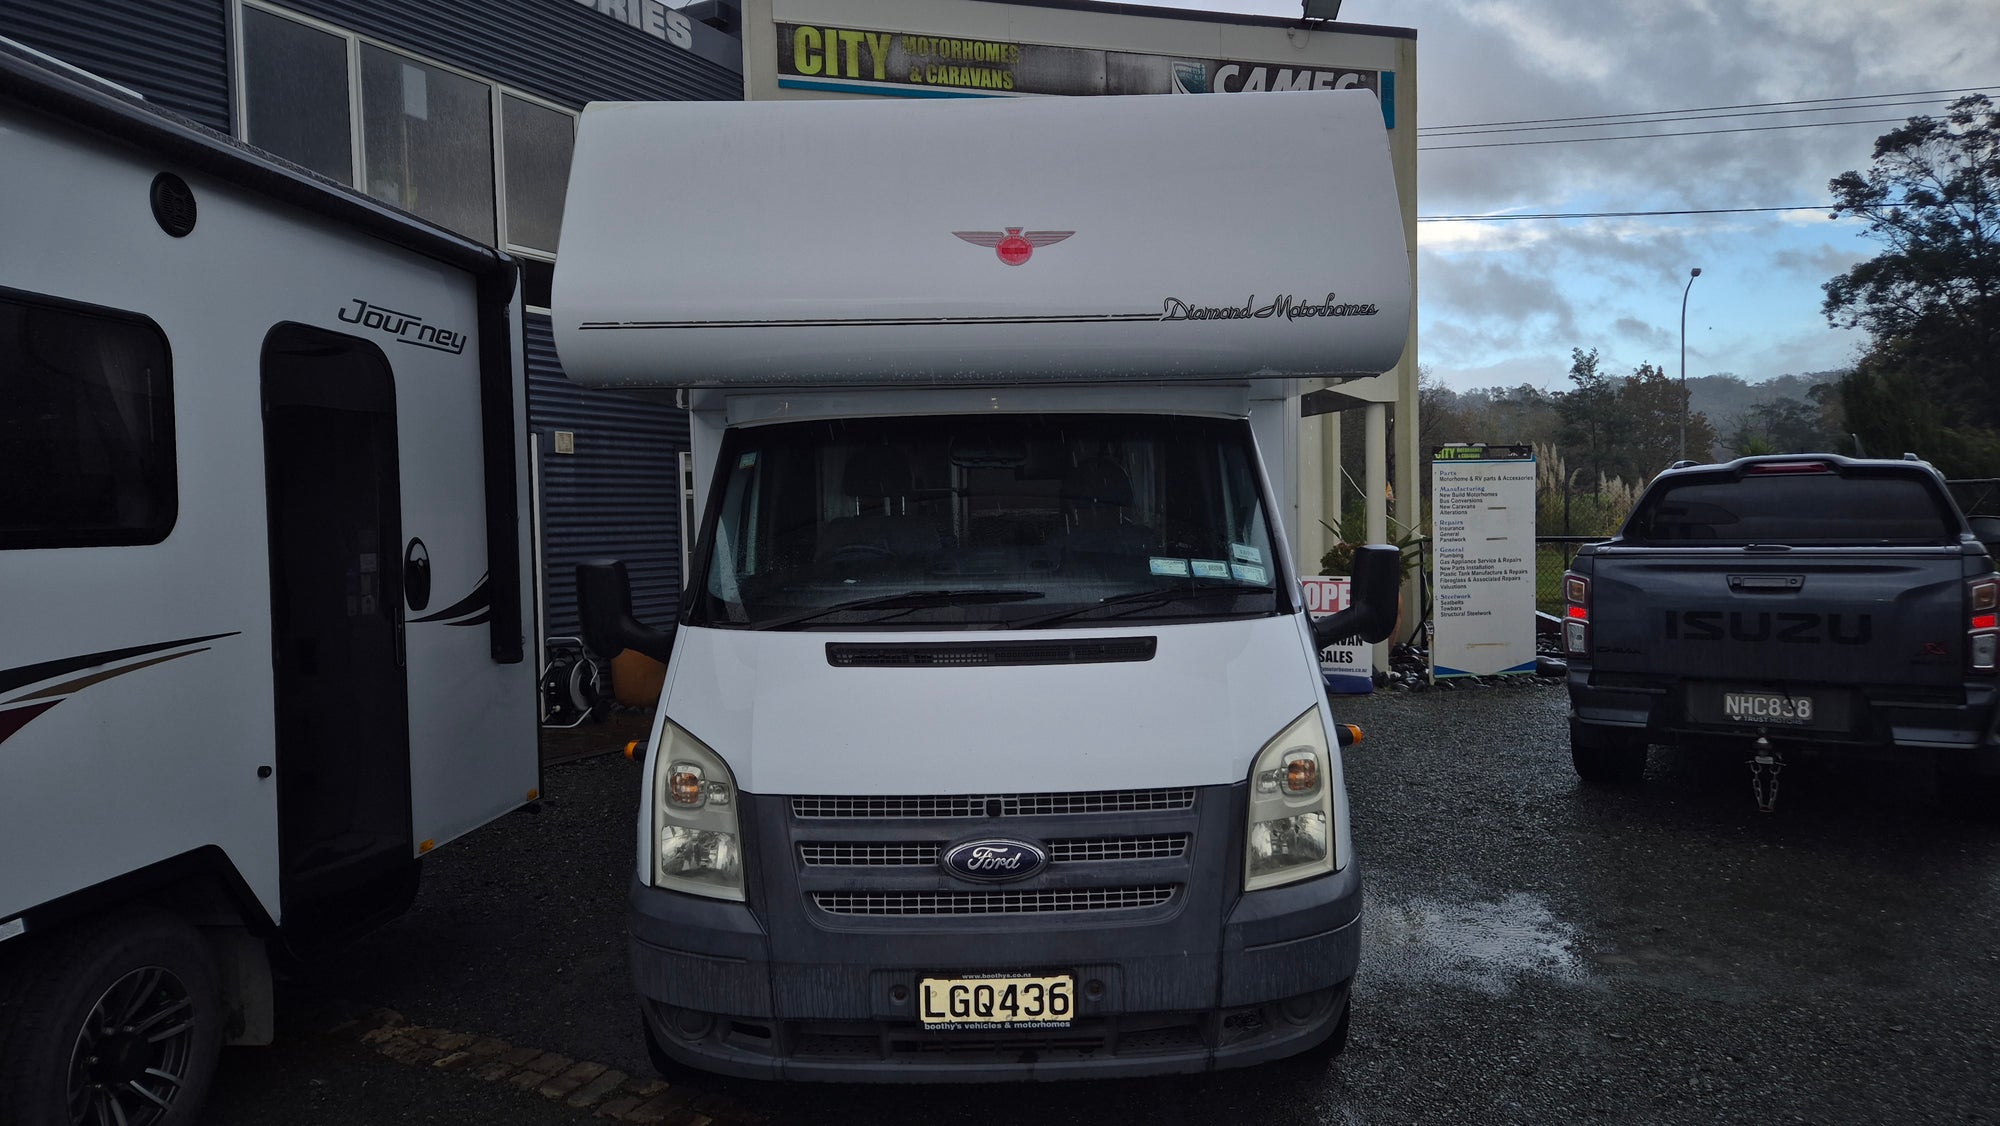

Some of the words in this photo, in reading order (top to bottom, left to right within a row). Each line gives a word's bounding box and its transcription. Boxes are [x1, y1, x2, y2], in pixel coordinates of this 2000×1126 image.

[573, 0, 692, 50] RIES
[793, 26, 892, 80] CITY
[901, 35, 1019, 64] MOTORHOMES
[909, 65, 923, 82] &
[926, 64, 1014, 90] CARAVANS
[1161, 294, 1255, 321] Diamond
[1254, 292, 1379, 322] Motorhomes
[338, 298, 467, 355] Journey
[1303, 582, 1351, 611] OPE
[1666, 610, 1872, 645] ISUZU
[1319, 650, 1353, 664] SALES
[1726, 695, 1811, 718] NHC838
[967, 846, 1022, 870] Ford
[961, 972, 1032, 980] www.boothys.co.nz
[924, 982, 1070, 1018] LGQ436
[924, 1021, 962, 1031] boothy's
[964, 1021, 1001, 1029] vehicles
[1004, 1021, 1011, 1029] &
[1013, 1020, 1071, 1029] motorhomes
